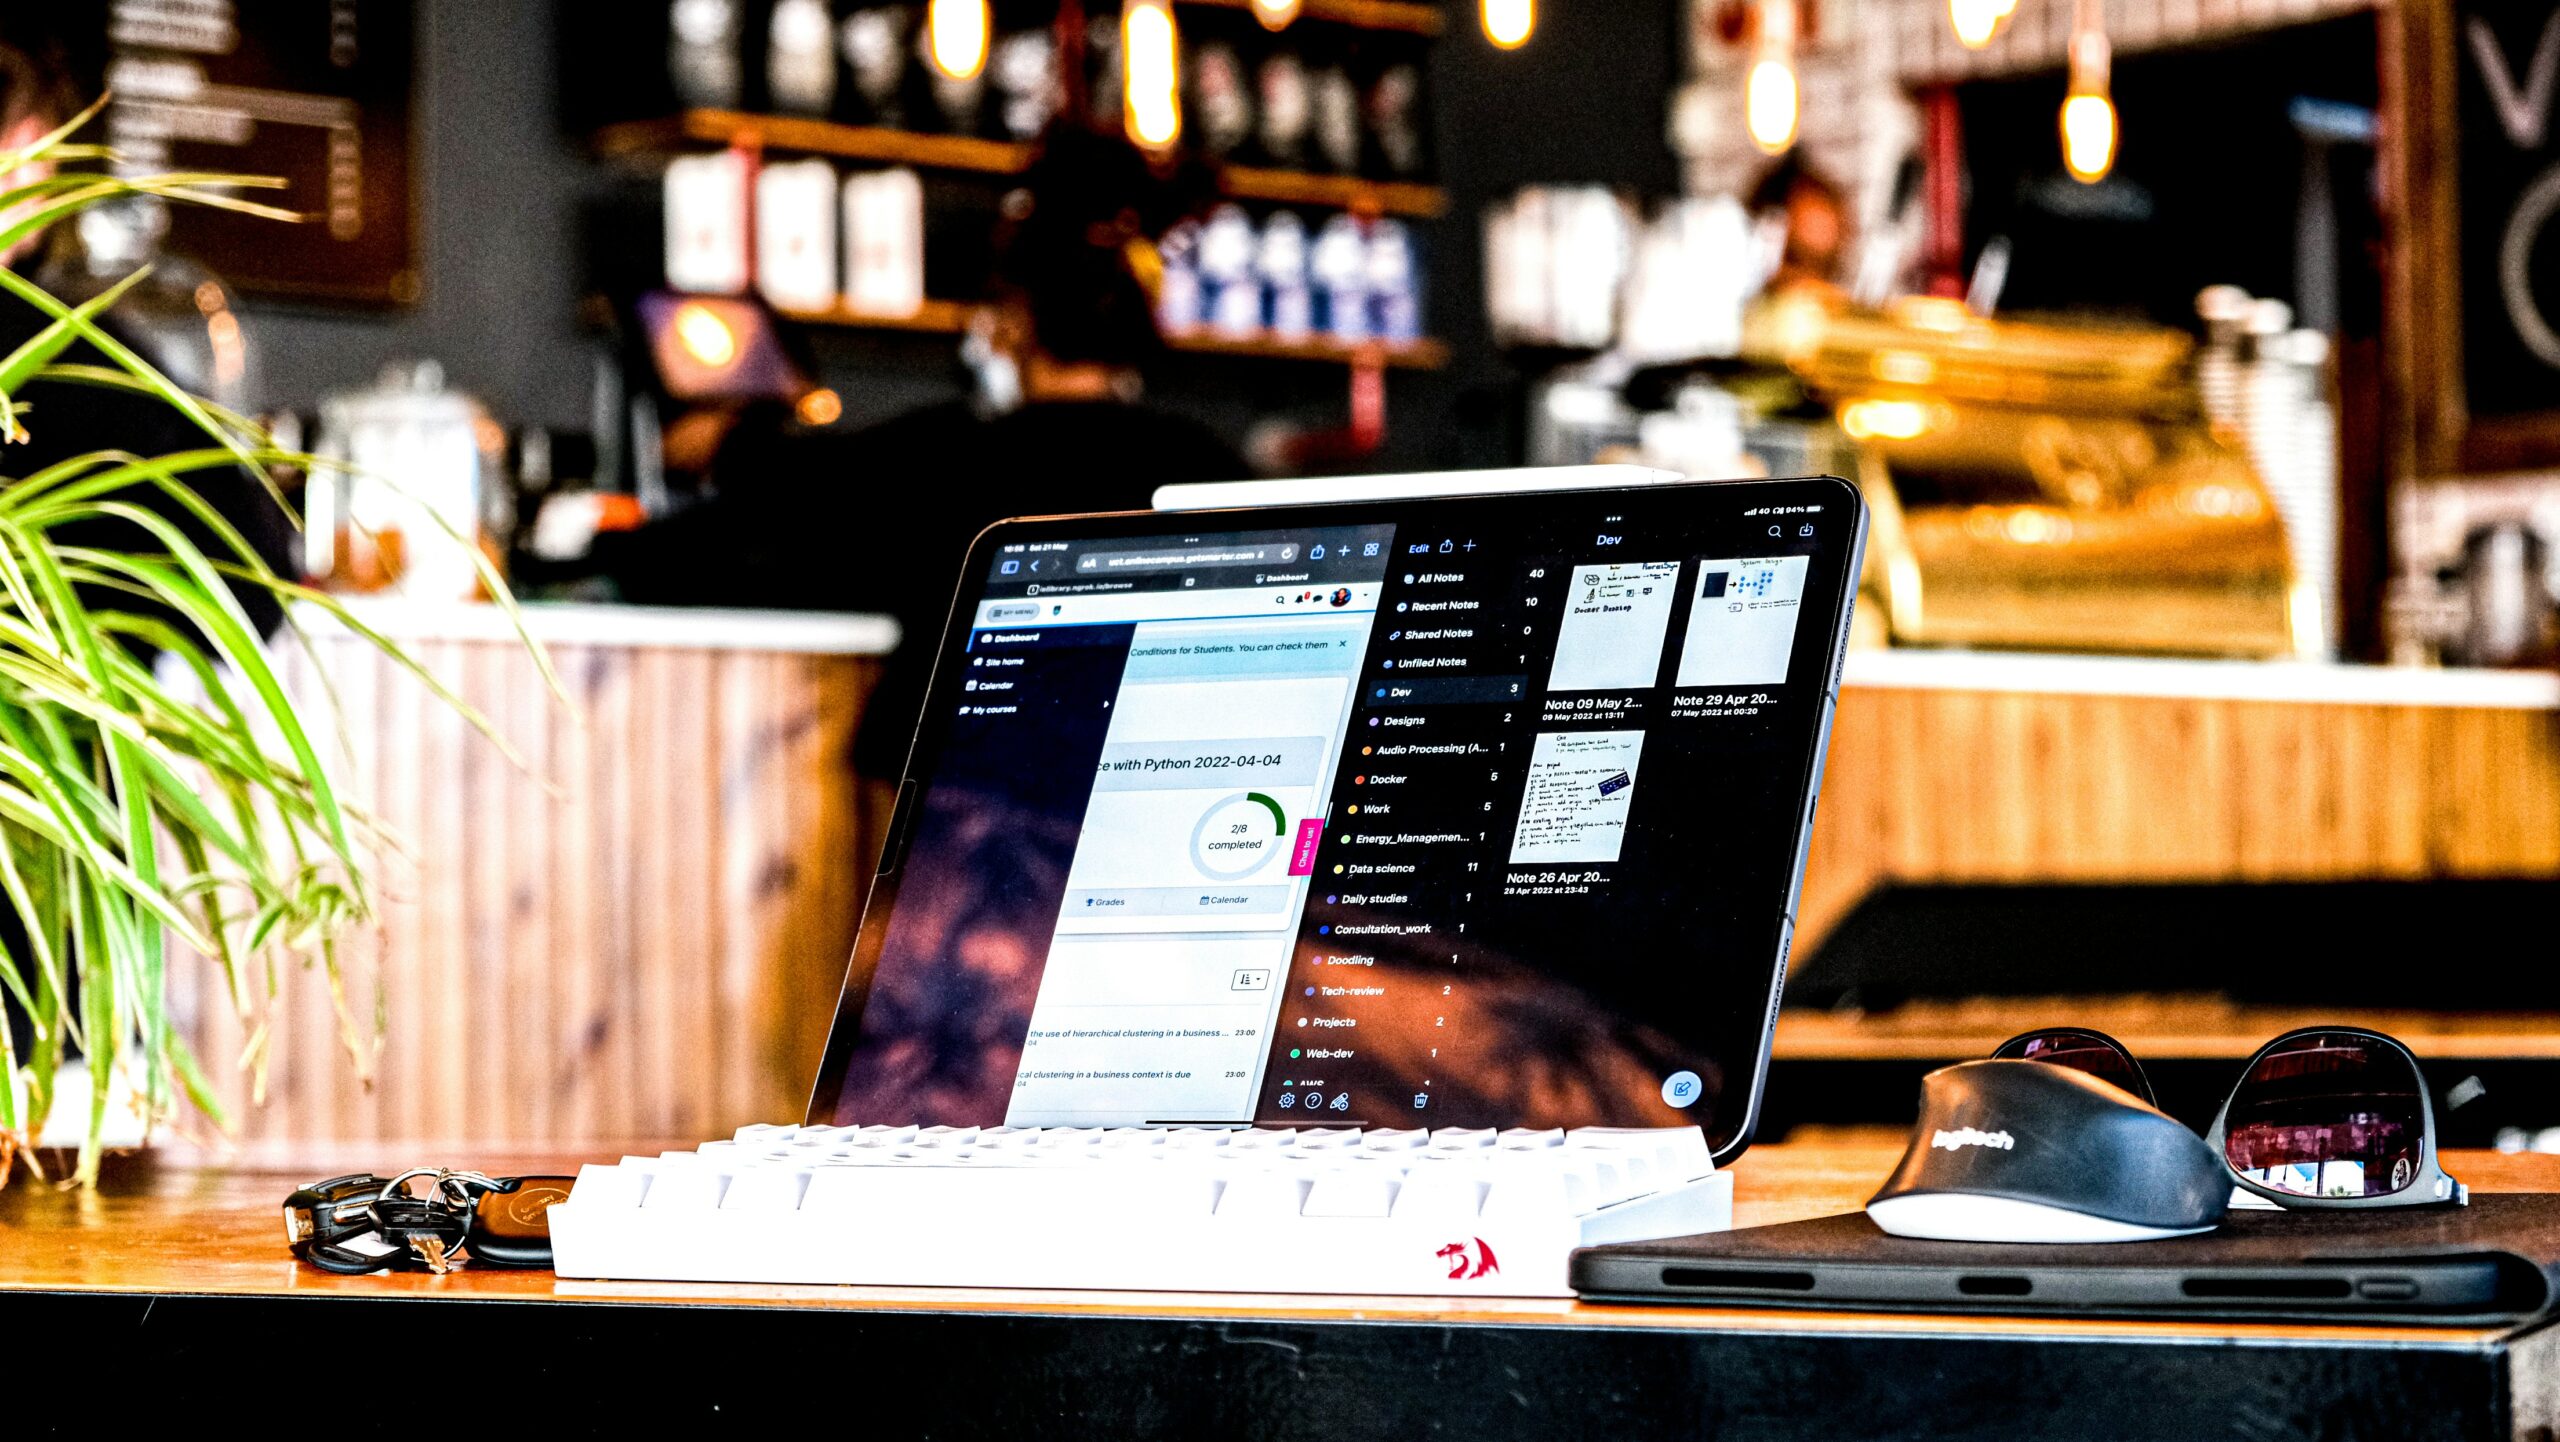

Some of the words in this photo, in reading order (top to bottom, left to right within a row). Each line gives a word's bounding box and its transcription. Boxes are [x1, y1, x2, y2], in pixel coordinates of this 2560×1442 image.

[1596, 535, 1622, 546] Dev
[1052, 543, 1068, 551] May
[1409, 544, 1430, 554] Edit
[1266, 573, 1309, 582] Dashboard
[1418, 574, 1432, 583] All
[1434, 573, 1464, 582] Notes
[1529, 569, 1544, 578] 40
[1412, 602, 1448, 611] Recent
[1449, 601, 1479, 610] Notes
[1525, 597, 1538, 607] 10
[1405, 629, 1441, 640] Shared
[1443, 629, 1473, 638] Notes
[1524, 626, 1531, 635] 0
[995, 633, 1040, 643] Dashboard
[1130, 647, 1177, 657] Conditions
[1179, 646, 1192, 655] for
[1193, 645, 1235, 654] Students.
[1239, 644, 1255, 652] You
[1276, 642, 1302, 650] check
[1305, 641, 1328, 649] them
[986, 658, 1000, 667] Site
[1002, 658, 1024, 666] home
[1398, 658, 1435, 668] Unfiled
[1436, 657, 1467, 667] Notes
[1519, 655, 1525, 664] 1
[979, 681, 1014, 690] Calendar
[1510, 684, 1518, 693] 3
[1391, 688, 1412, 697] Dev
[1545, 700, 1574, 710] Note
[1576, 699, 1594, 709] 09
[1596, 698, 1622, 710] May
[1674, 696, 1703, 706] Note
[1705, 695, 1723, 705] 29
[1725, 694, 1748, 706] Apr
[973, 707, 984, 715] My
[986, 706, 1017, 714] courses
[1683, 709, 1700, 718] May
[1384, 716, 1425, 727] Designs
[1504, 713, 1512, 722] 2
[1555, 714, 1571, 722] May
[1377, 746, 1407, 756] Audio
[1409, 744, 1465, 755] Processing
[1499, 743, 1505, 751] 1
[1113, 759, 1141, 771] with
[1144, 757, 1191, 772] Python
[1194, 754, 1281, 768] 2022-04-04
[1370, 775, 1407, 785] Docker
[1491, 772, 1498, 781] 5
[1364, 804, 1390, 814] Work
[1484, 802, 1492, 811] 5
[1231, 824, 1247, 834] 2/8
[1479, 832, 1485, 841] 1
[1208, 840, 1262, 851] completed
[1349, 864, 1373, 874] Data
[1375, 864, 1415, 873] science
[1467, 862, 1478, 872] 11
[1506, 873, 1536, 883] Note
[1539, 872, 1555, 883] 26
[1558, 872, 1581, 884] Apr
[1516, 887, 1531, 895] Apr
[1564, 886, 1588, 894] 23:43
[1095, 898, 1125, 906] Grades
[1210, 896, 1248, 904] Calendar
[1342, 894, 1368, 905] Daily
[1369, 893, 1407, 903] studies
[1466, 893, 1472, 902] 1
[1334, 924, 1432, 935] Consultation_work
[1459, 924, 1464, 933] 1
[1328, 956, 1374, 966] Doodling
[1452, 955, 1458, 964] 1
[1321, 986, 1384, 996] Tech-review
[1442, 986, 1451, 995] 2
[1313, 1017, 1356, 1028] Projects
[1436, 1017, 1444, 1027] 2
[1030, 1030, 1043, 1038] the
[1062, 1030, 1072, 1038] of
[1072, 1030, 1121, 1038] hierarchical
[1122, 1030, 1164, 1038] clustering
[1183, 1029, 1220, 1037] business
[1306, 1049, 1354, 1058] Web-dev
[1431, 1048, 1437, 1058] 1
[1033, 1071, 1074, 1079] clustering
